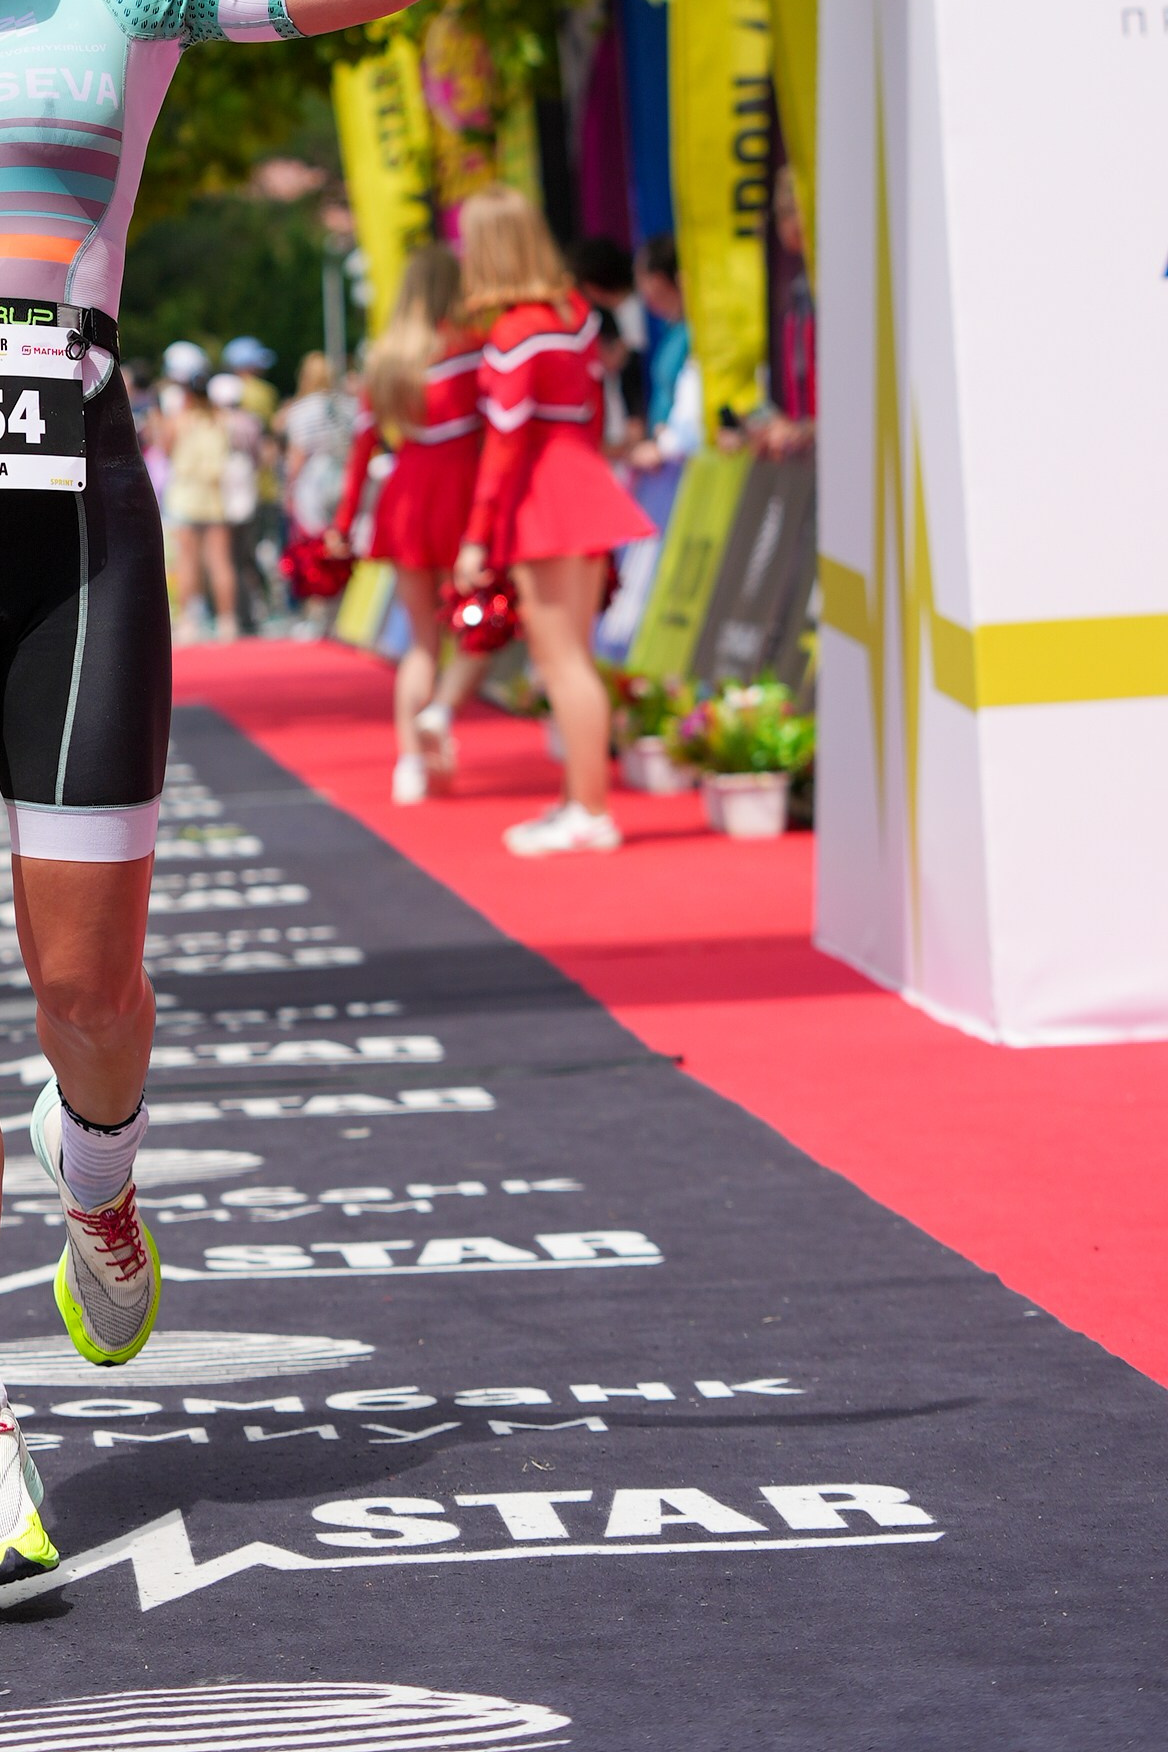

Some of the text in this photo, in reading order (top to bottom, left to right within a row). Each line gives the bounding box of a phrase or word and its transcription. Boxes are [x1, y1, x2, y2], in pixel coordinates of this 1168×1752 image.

[50, 478, 74, 487] SPRINT
[204, 1230, 662, 1272] STAR
[312, 1482, 938, 1549] STAR
